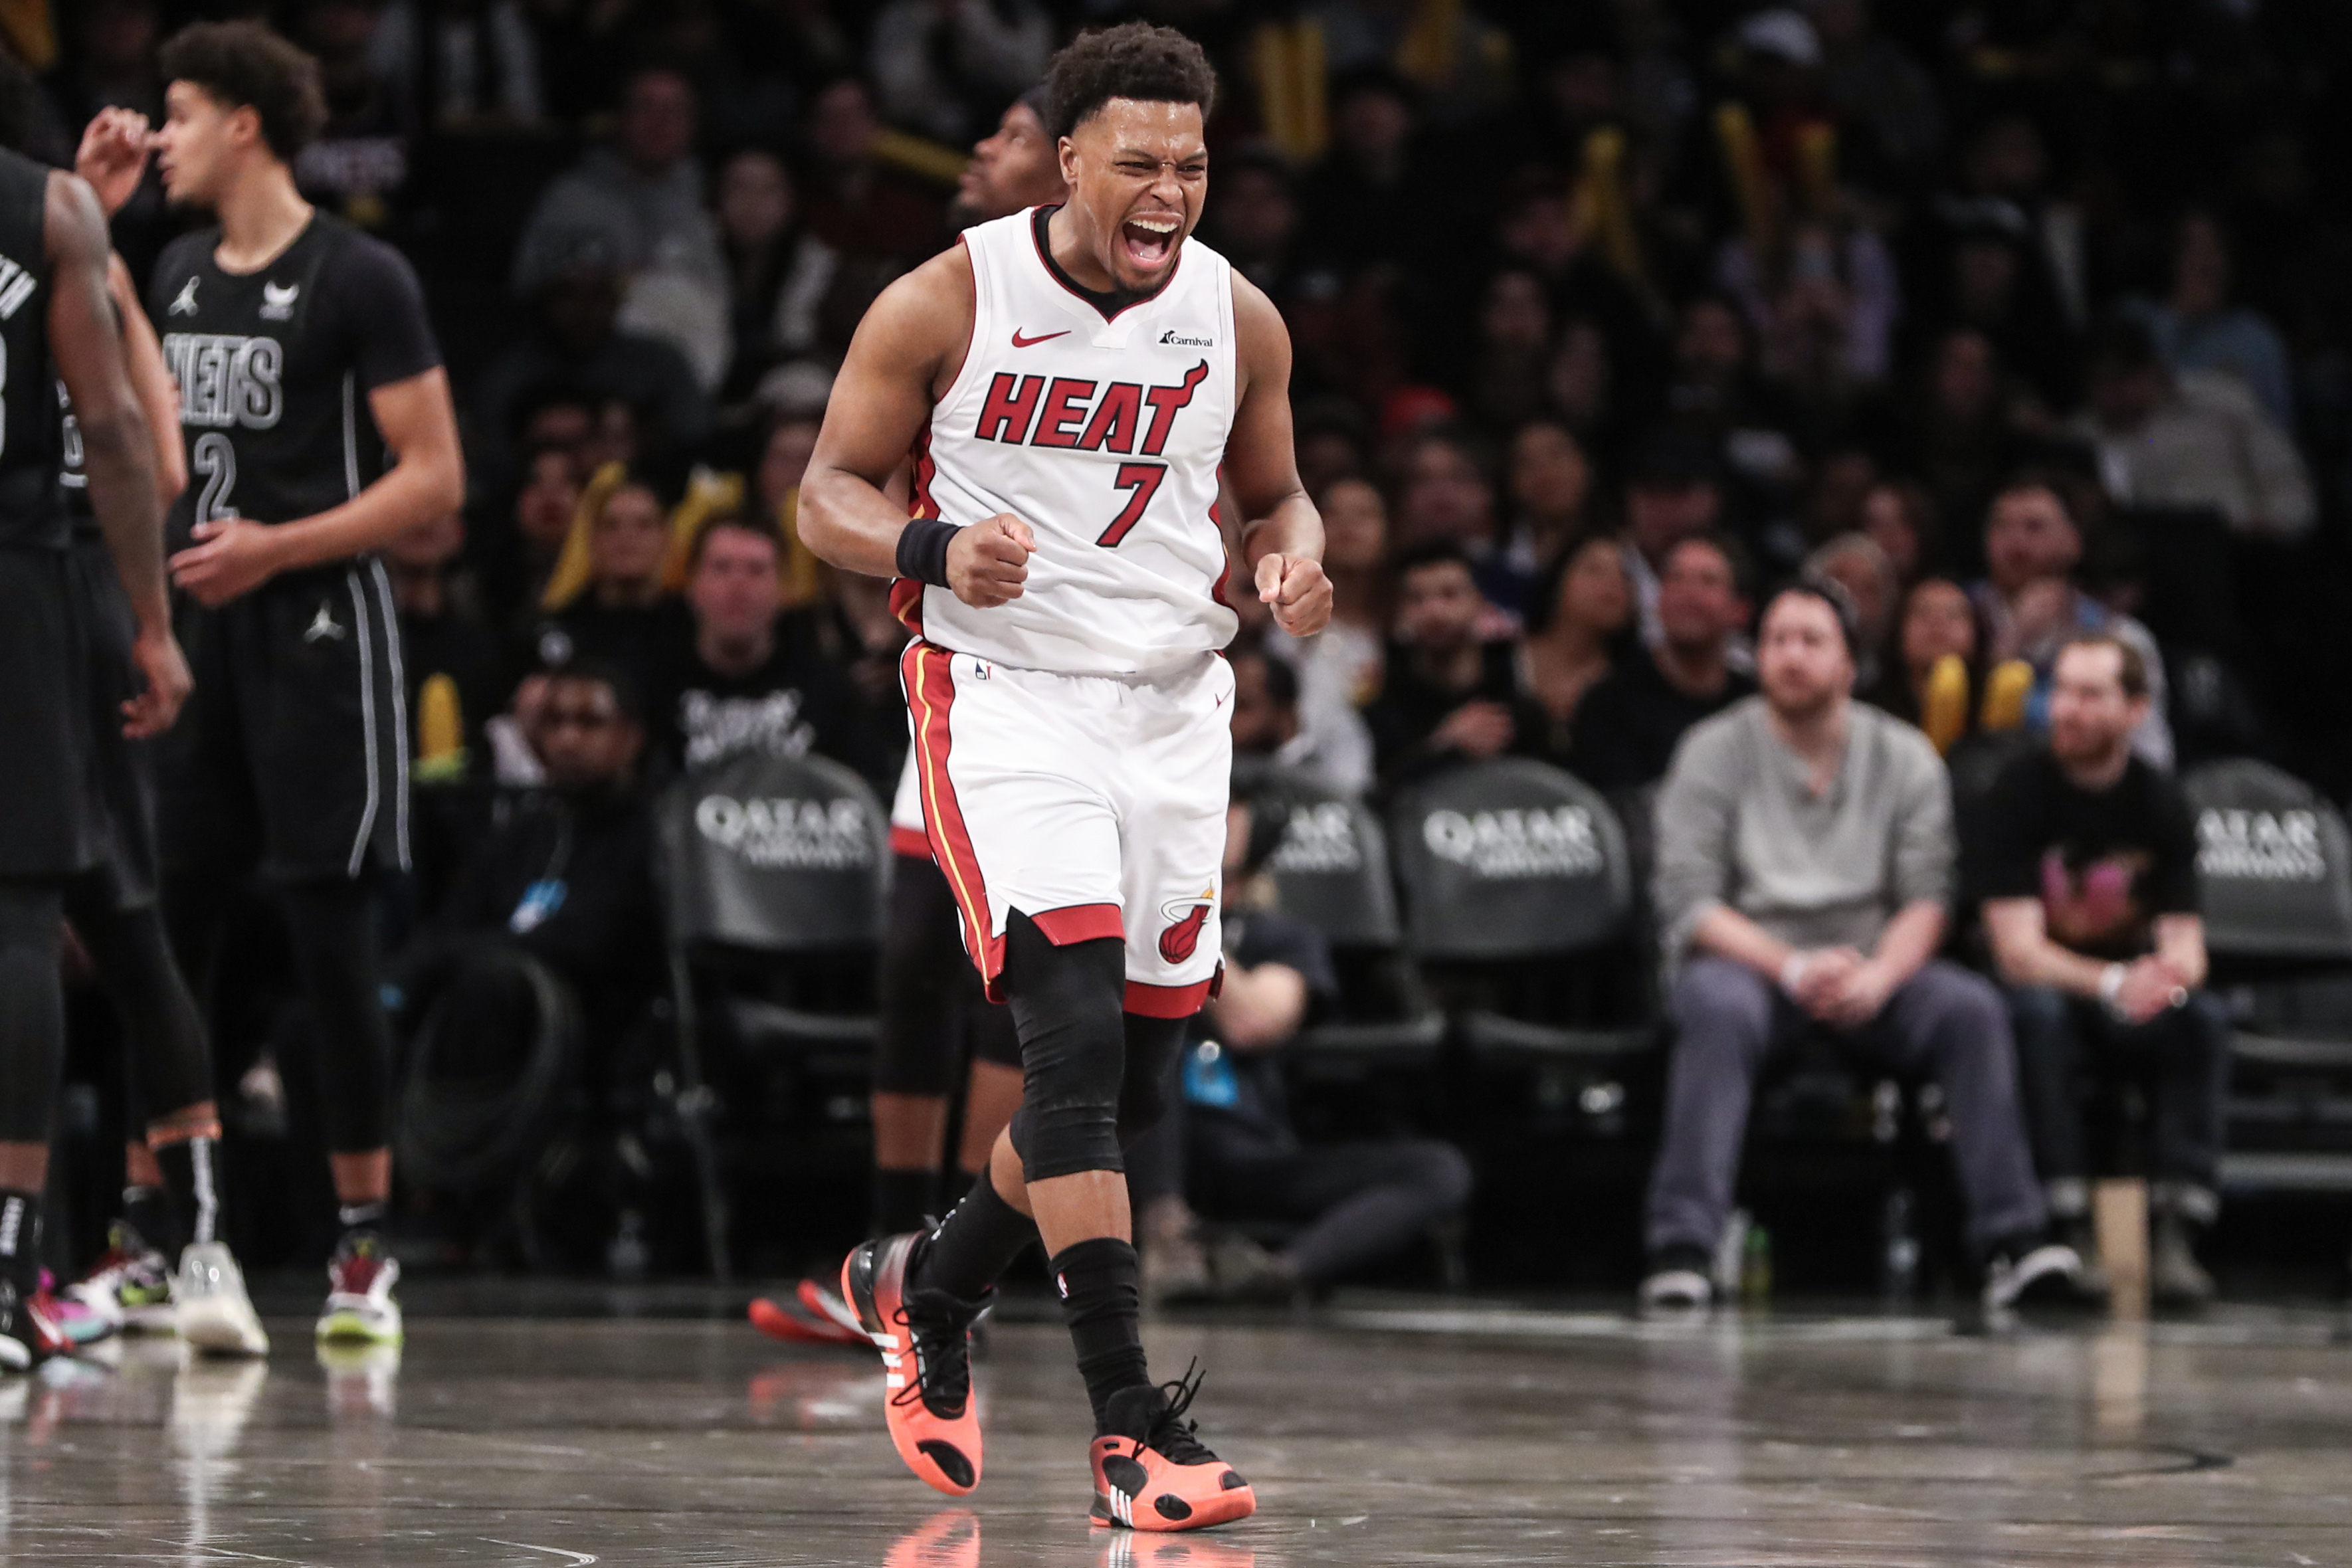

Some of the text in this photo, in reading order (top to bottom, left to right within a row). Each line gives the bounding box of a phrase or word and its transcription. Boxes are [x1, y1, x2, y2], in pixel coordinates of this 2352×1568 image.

[1171, 336, 1213, 347] Carnival
[974, 358, 1209, 456] HEAT
[193, 431, 240, 526] 2
[1094, 462, 1169, 547] 7
[695, 795, 866, 846] QATAR
[1422, 807, 1596, 865] QATAR
[2195, 808, 2320, 852] ATAR
